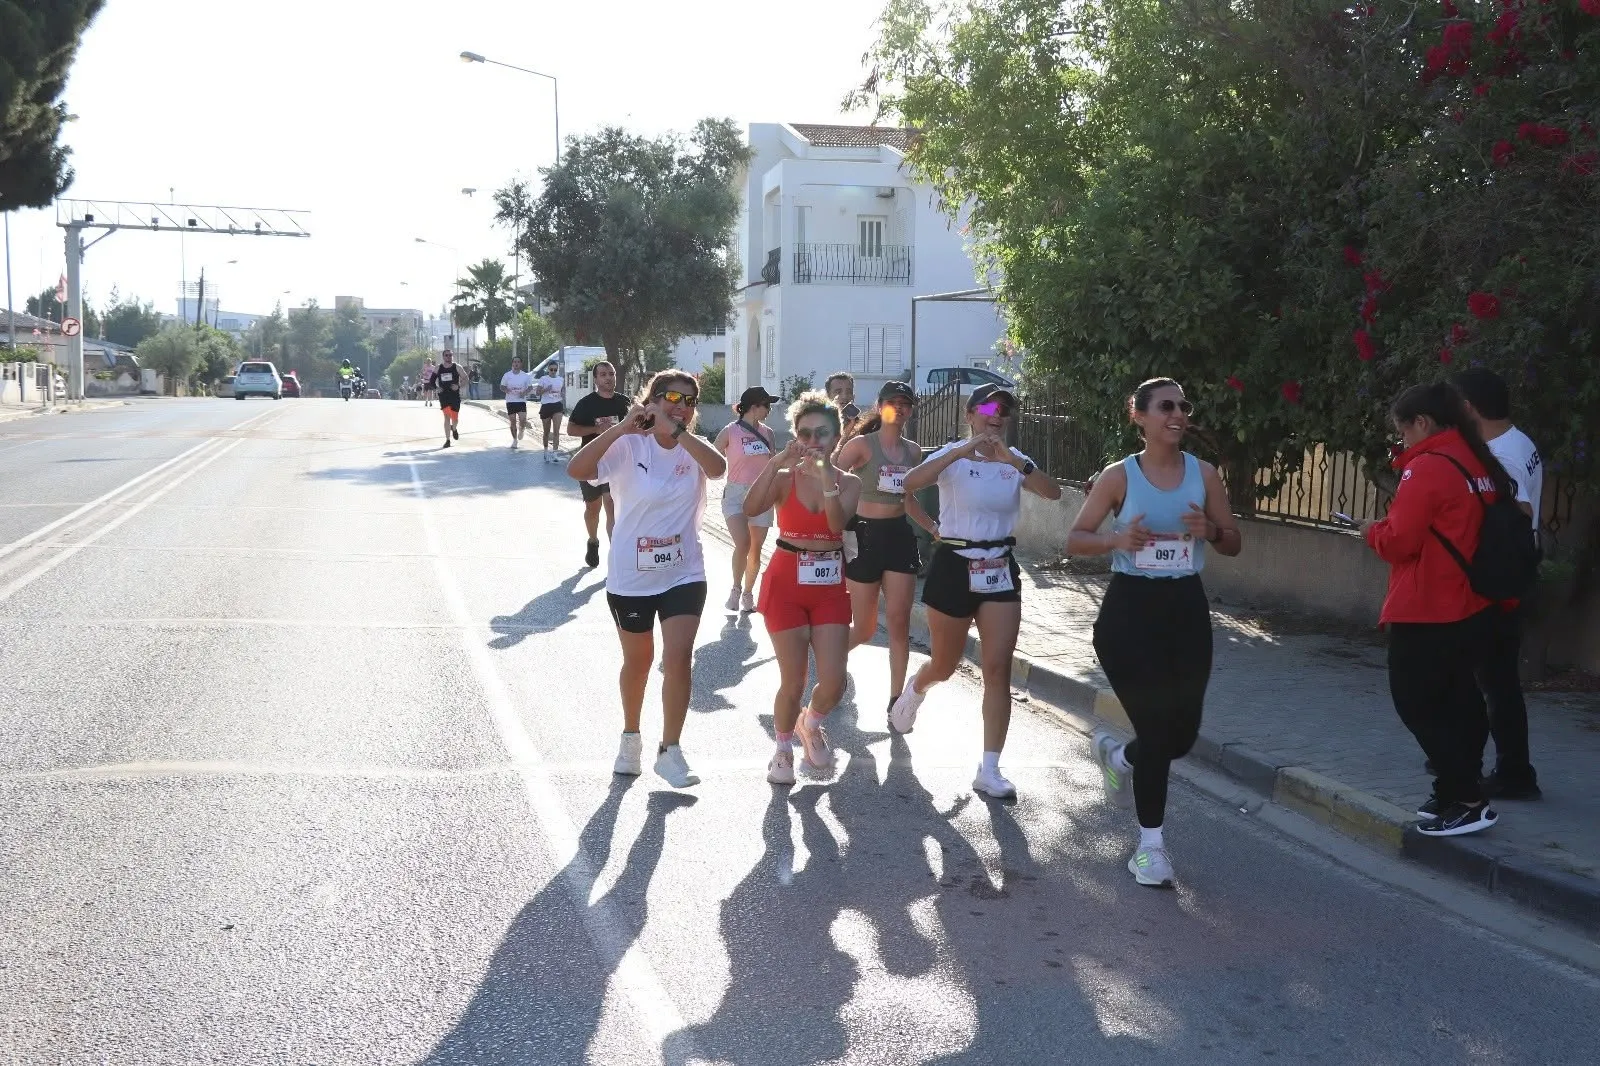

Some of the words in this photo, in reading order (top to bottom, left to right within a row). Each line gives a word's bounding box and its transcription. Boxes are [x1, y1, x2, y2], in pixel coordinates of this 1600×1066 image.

[654, 552, 671, 563] 094
[1155, 549, 1176, 561] 097
[815, 567, 830, 578] 087
